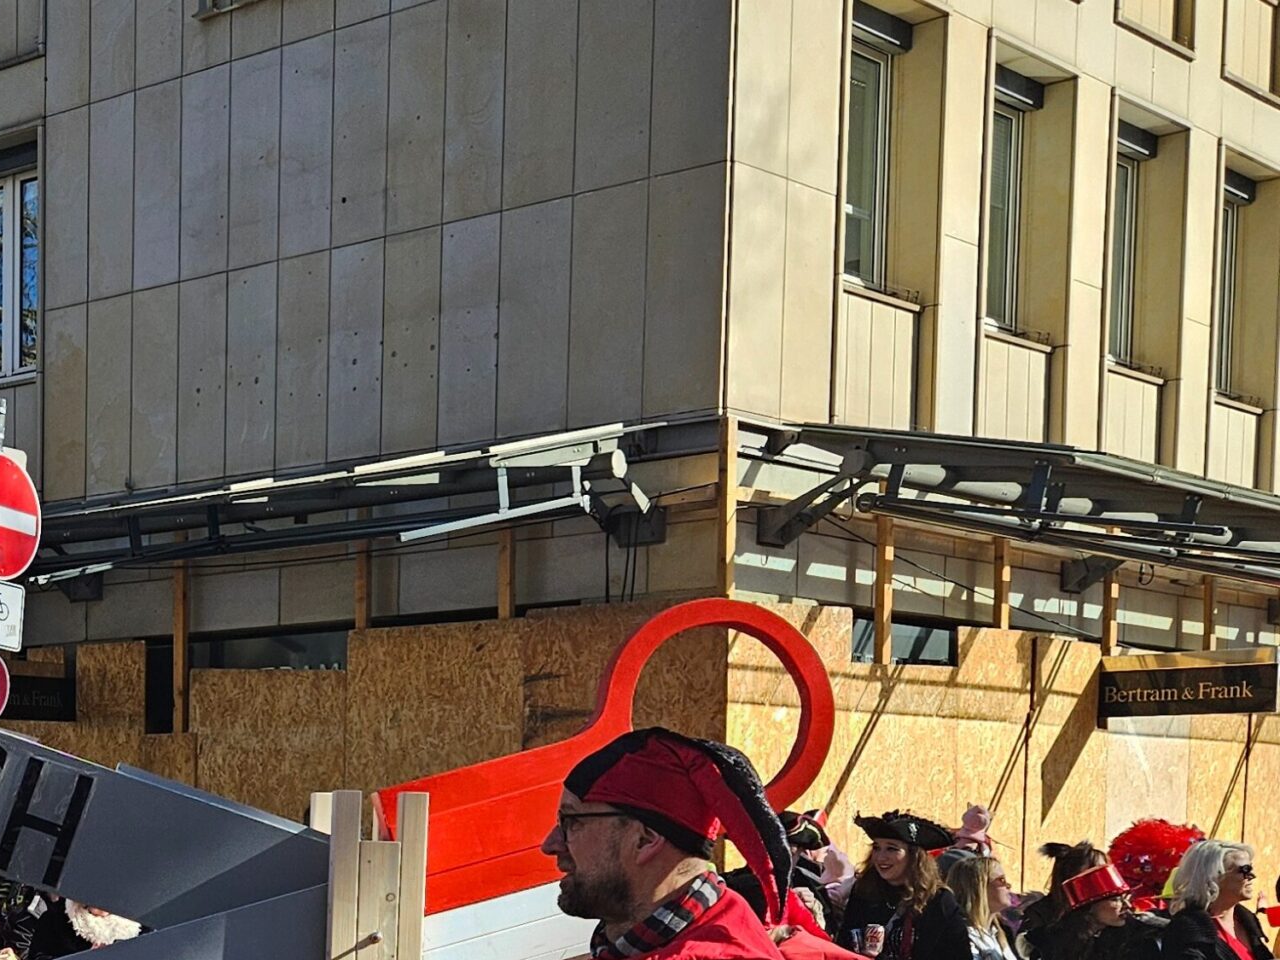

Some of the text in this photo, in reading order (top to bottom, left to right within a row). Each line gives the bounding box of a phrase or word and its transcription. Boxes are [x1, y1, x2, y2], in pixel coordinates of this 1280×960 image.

[1104, 680, 1254, 704] Bertram & Frank
